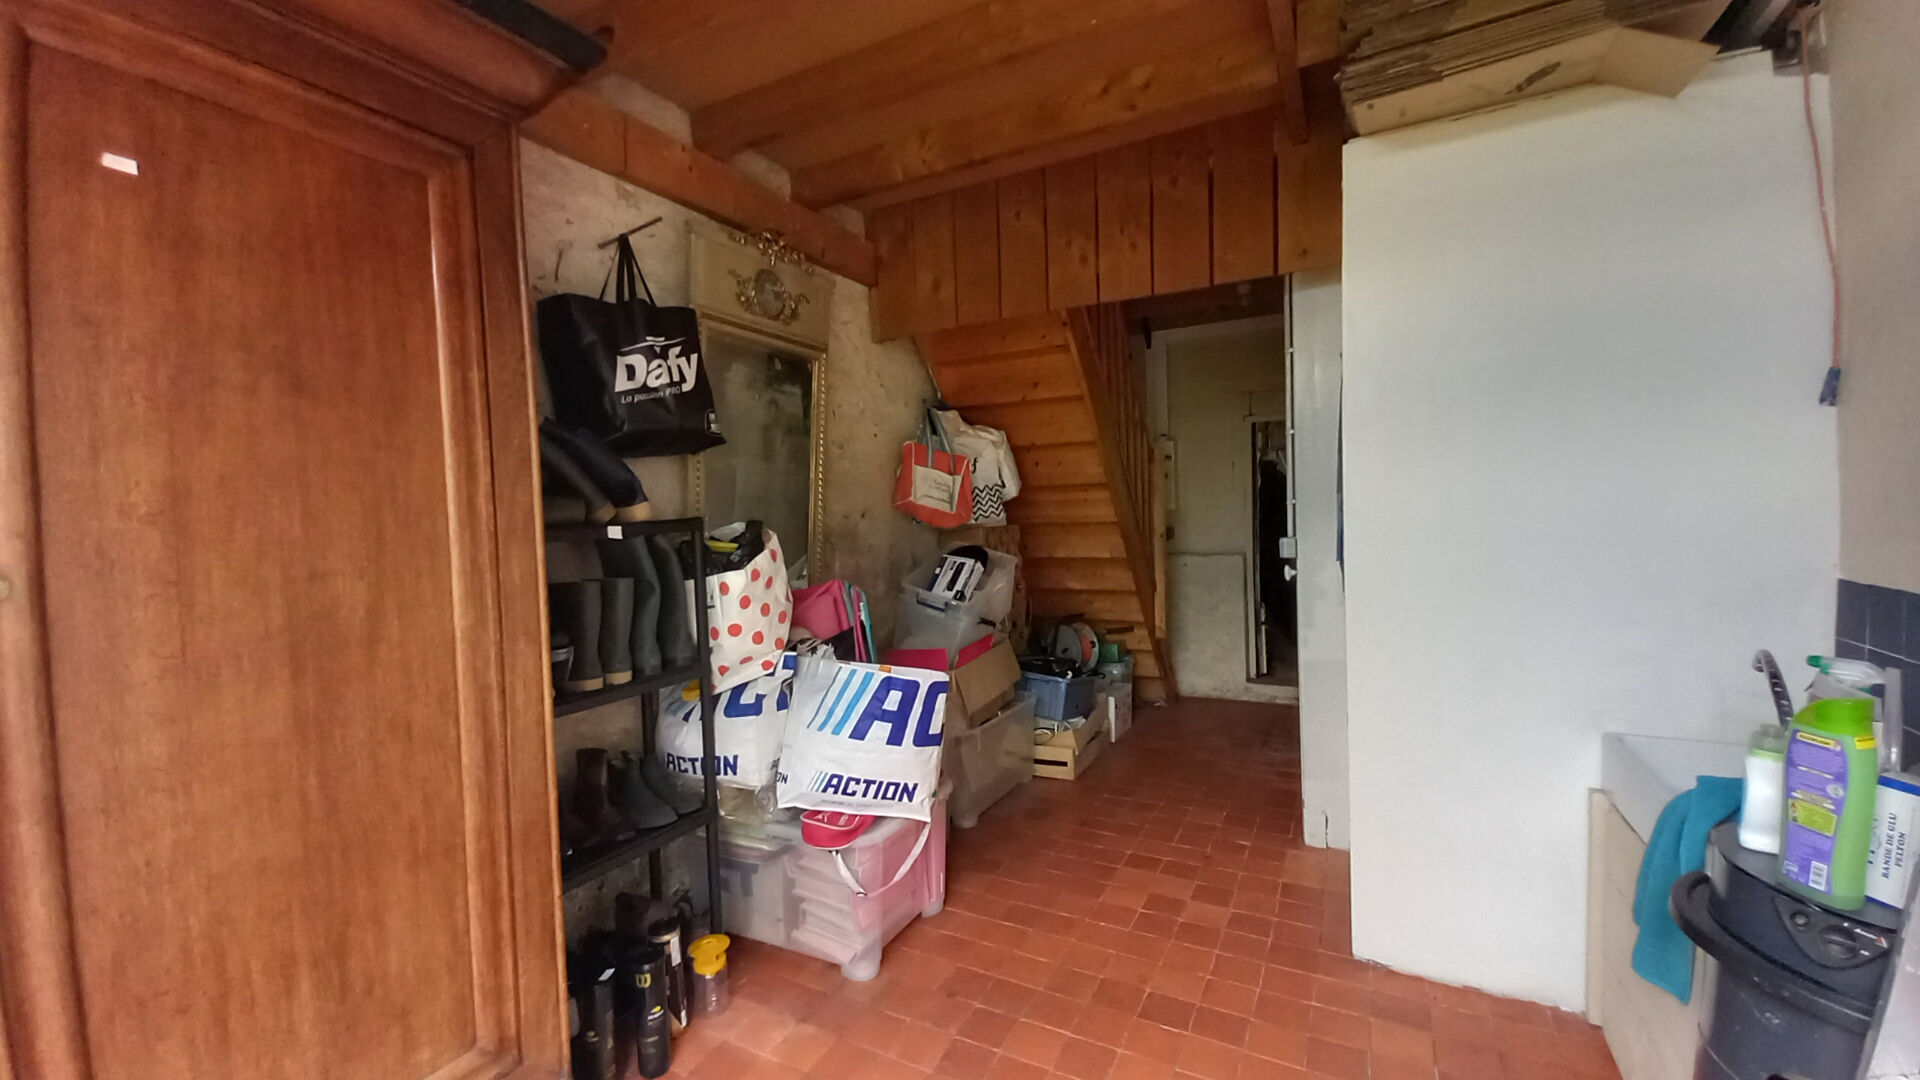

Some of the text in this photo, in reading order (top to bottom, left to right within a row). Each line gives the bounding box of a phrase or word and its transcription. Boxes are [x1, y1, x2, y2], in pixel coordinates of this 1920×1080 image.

[615, 346, 698, 392] Dafy
[848, 675, 949, 748] AC
[821, 773, 919, 803] ACTION
[1881, 813, 1896, 878] BANDE DE GLU
